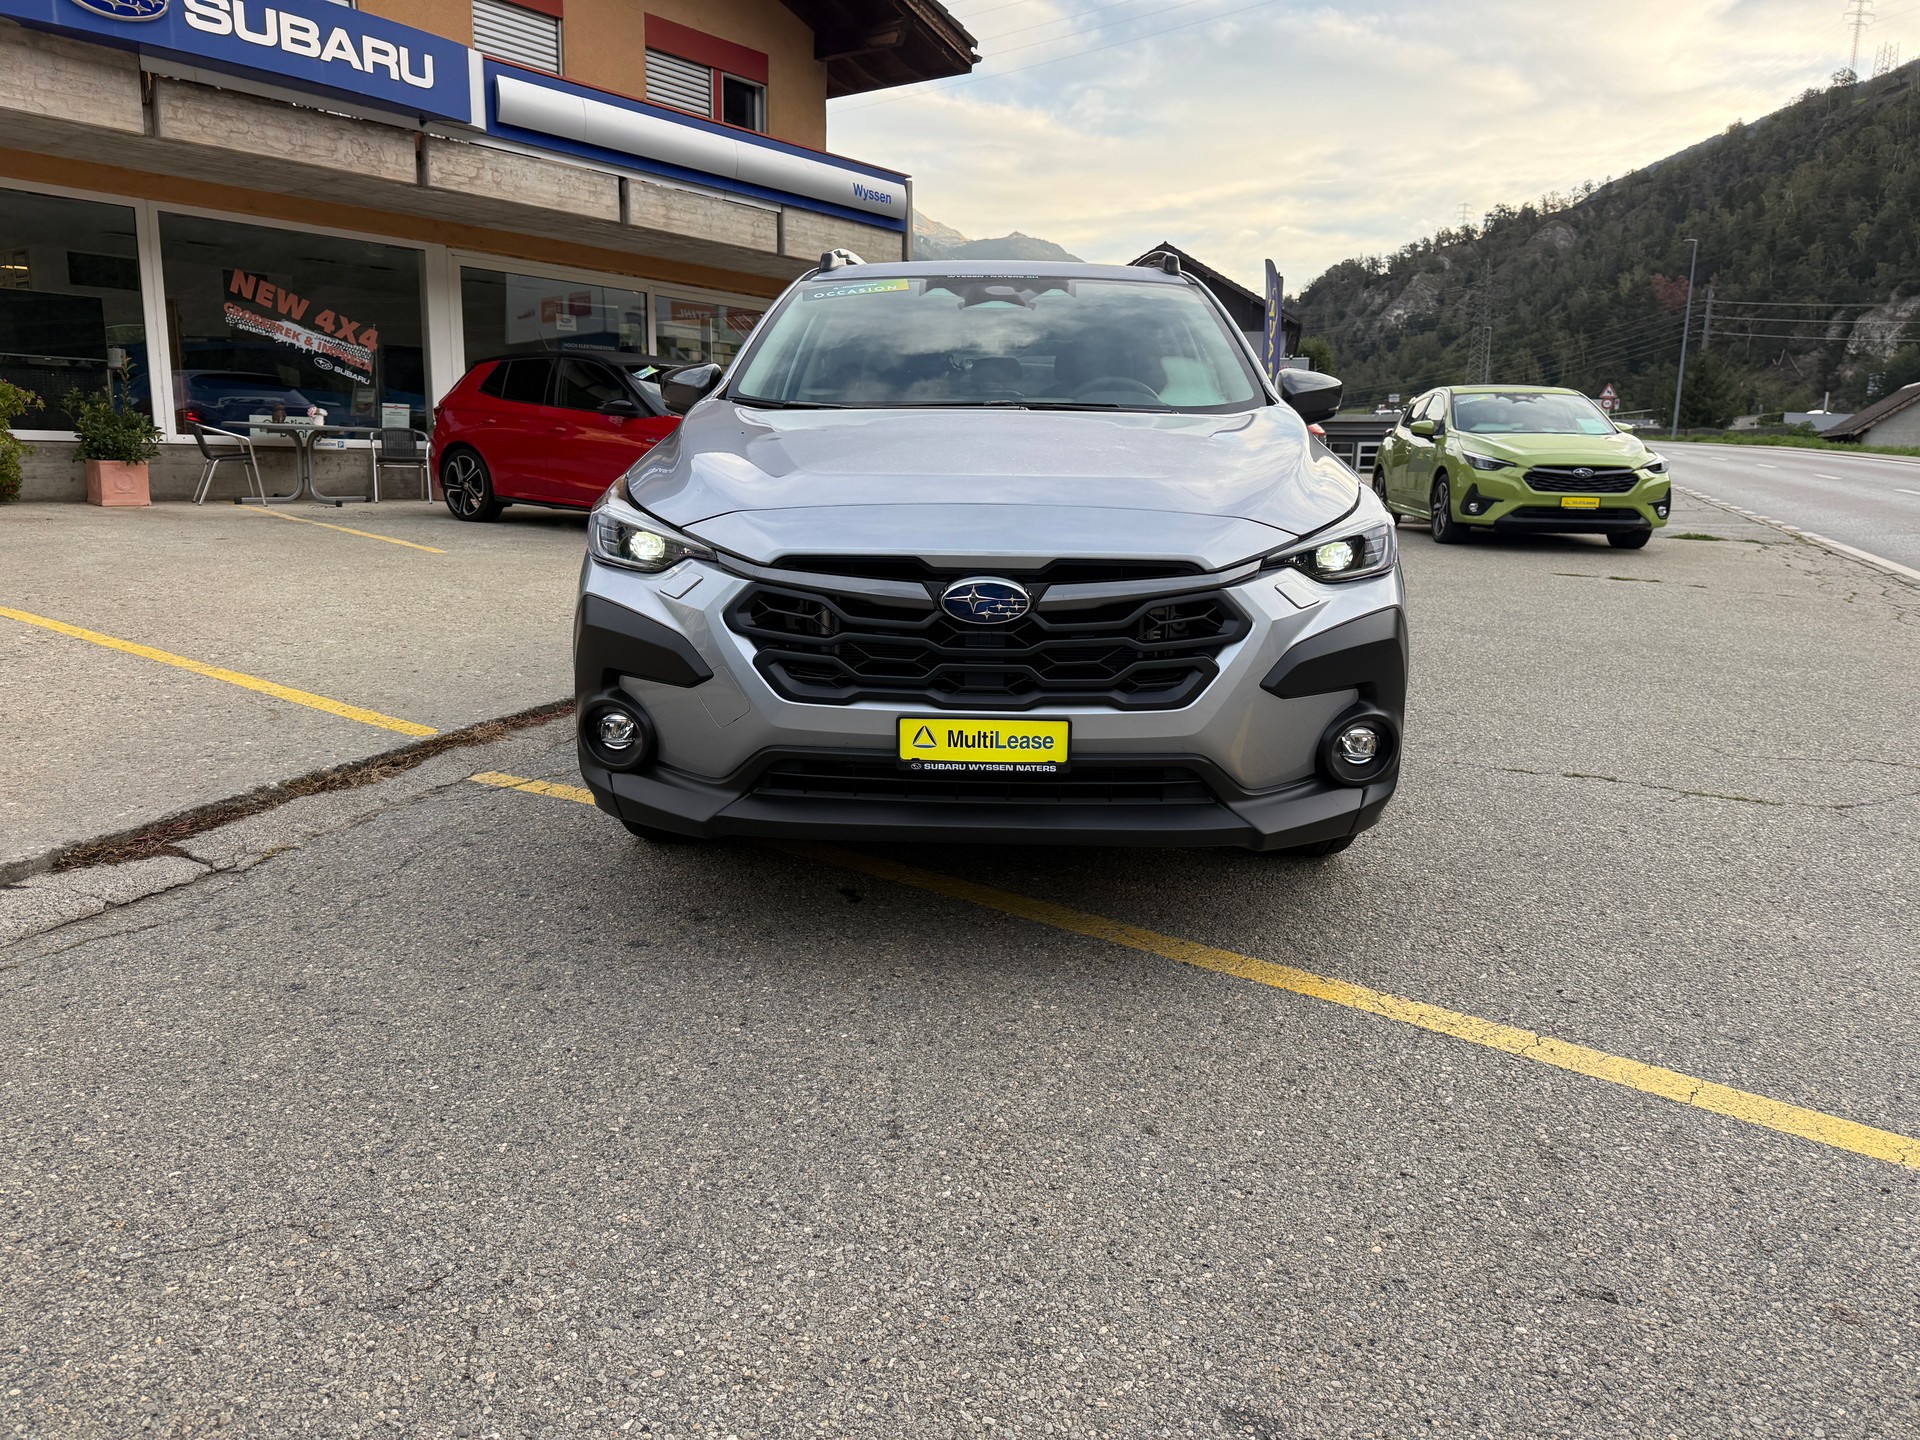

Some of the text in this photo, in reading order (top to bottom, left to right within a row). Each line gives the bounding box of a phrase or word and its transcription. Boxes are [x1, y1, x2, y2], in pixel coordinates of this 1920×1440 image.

[183, 0, 435, 89] SUBARU
[853, 182, 892, 205] Wyssen
[814, 285, 897, 298] OCCASION
[229, 268, 379, 353] NEW 4X4
[304, 336, 314, 349] &
[334, 366, 371, 385] SUBARU
[947, 729, 1055, 750] MultiLease
[924, 763, 1057, 772] SUBARU WYSSEN NATERS
